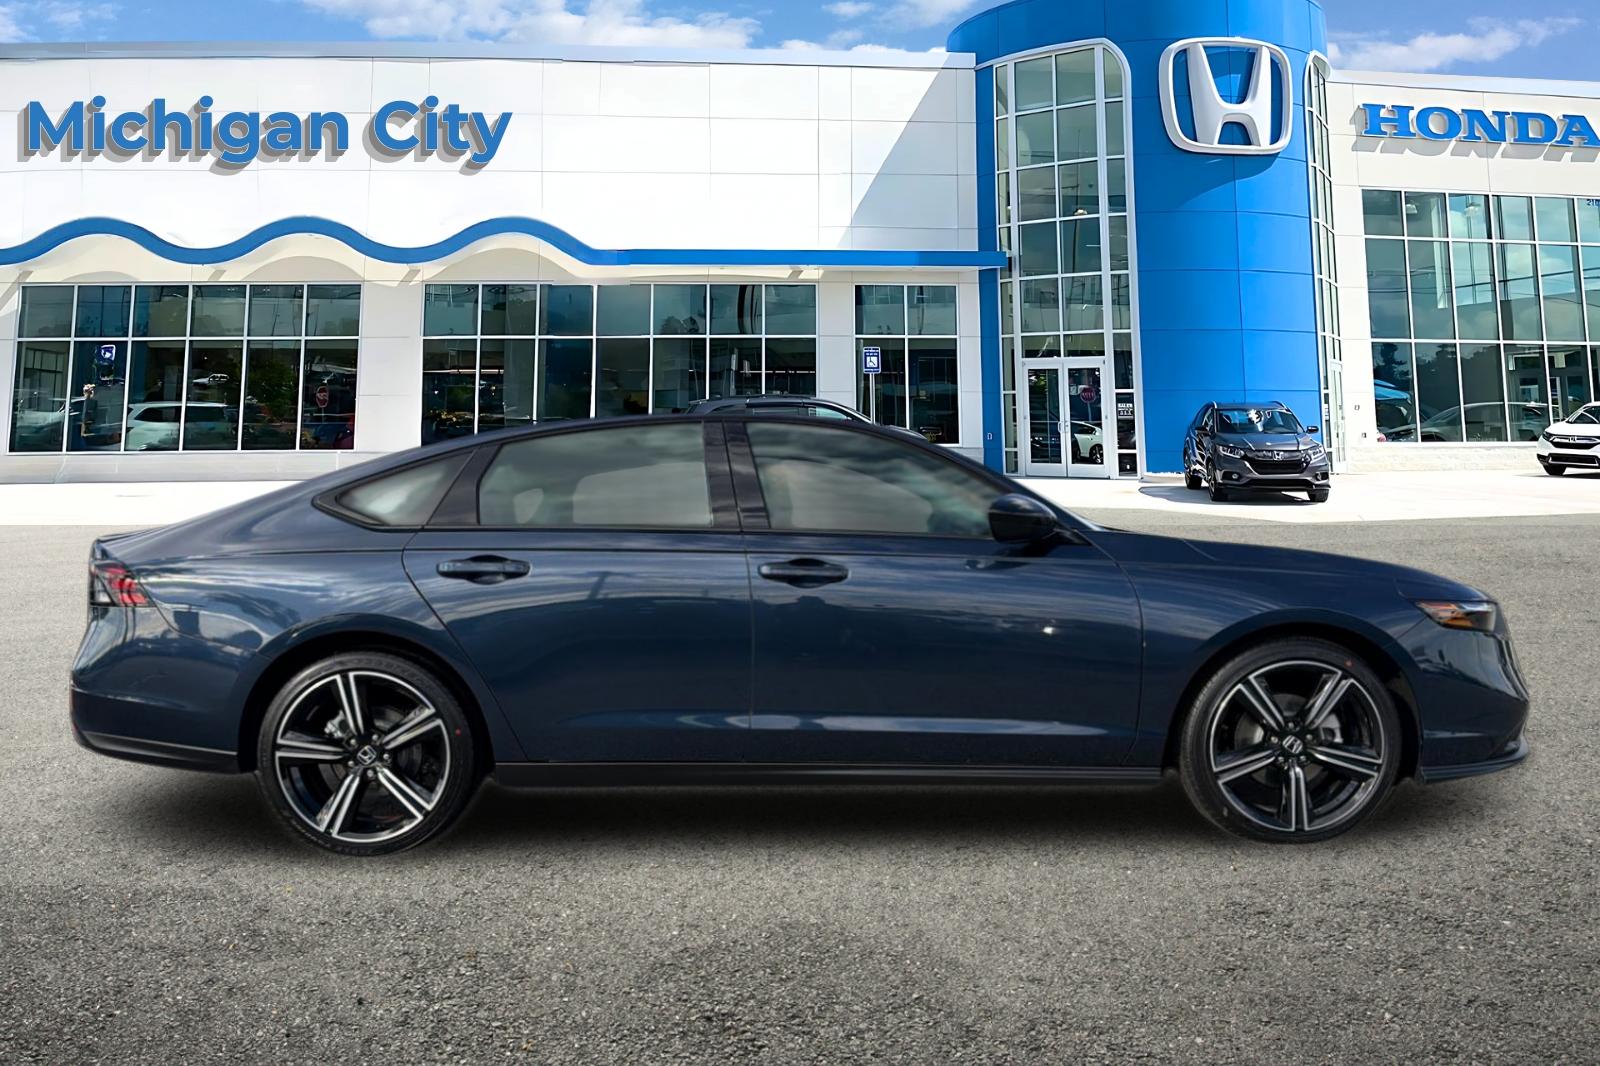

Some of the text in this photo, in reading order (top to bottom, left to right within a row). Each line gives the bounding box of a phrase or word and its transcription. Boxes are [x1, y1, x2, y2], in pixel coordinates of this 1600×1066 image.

[29, 95, 513, 163] Michigan City
[1361, 103, 1600, 147] HONDA
